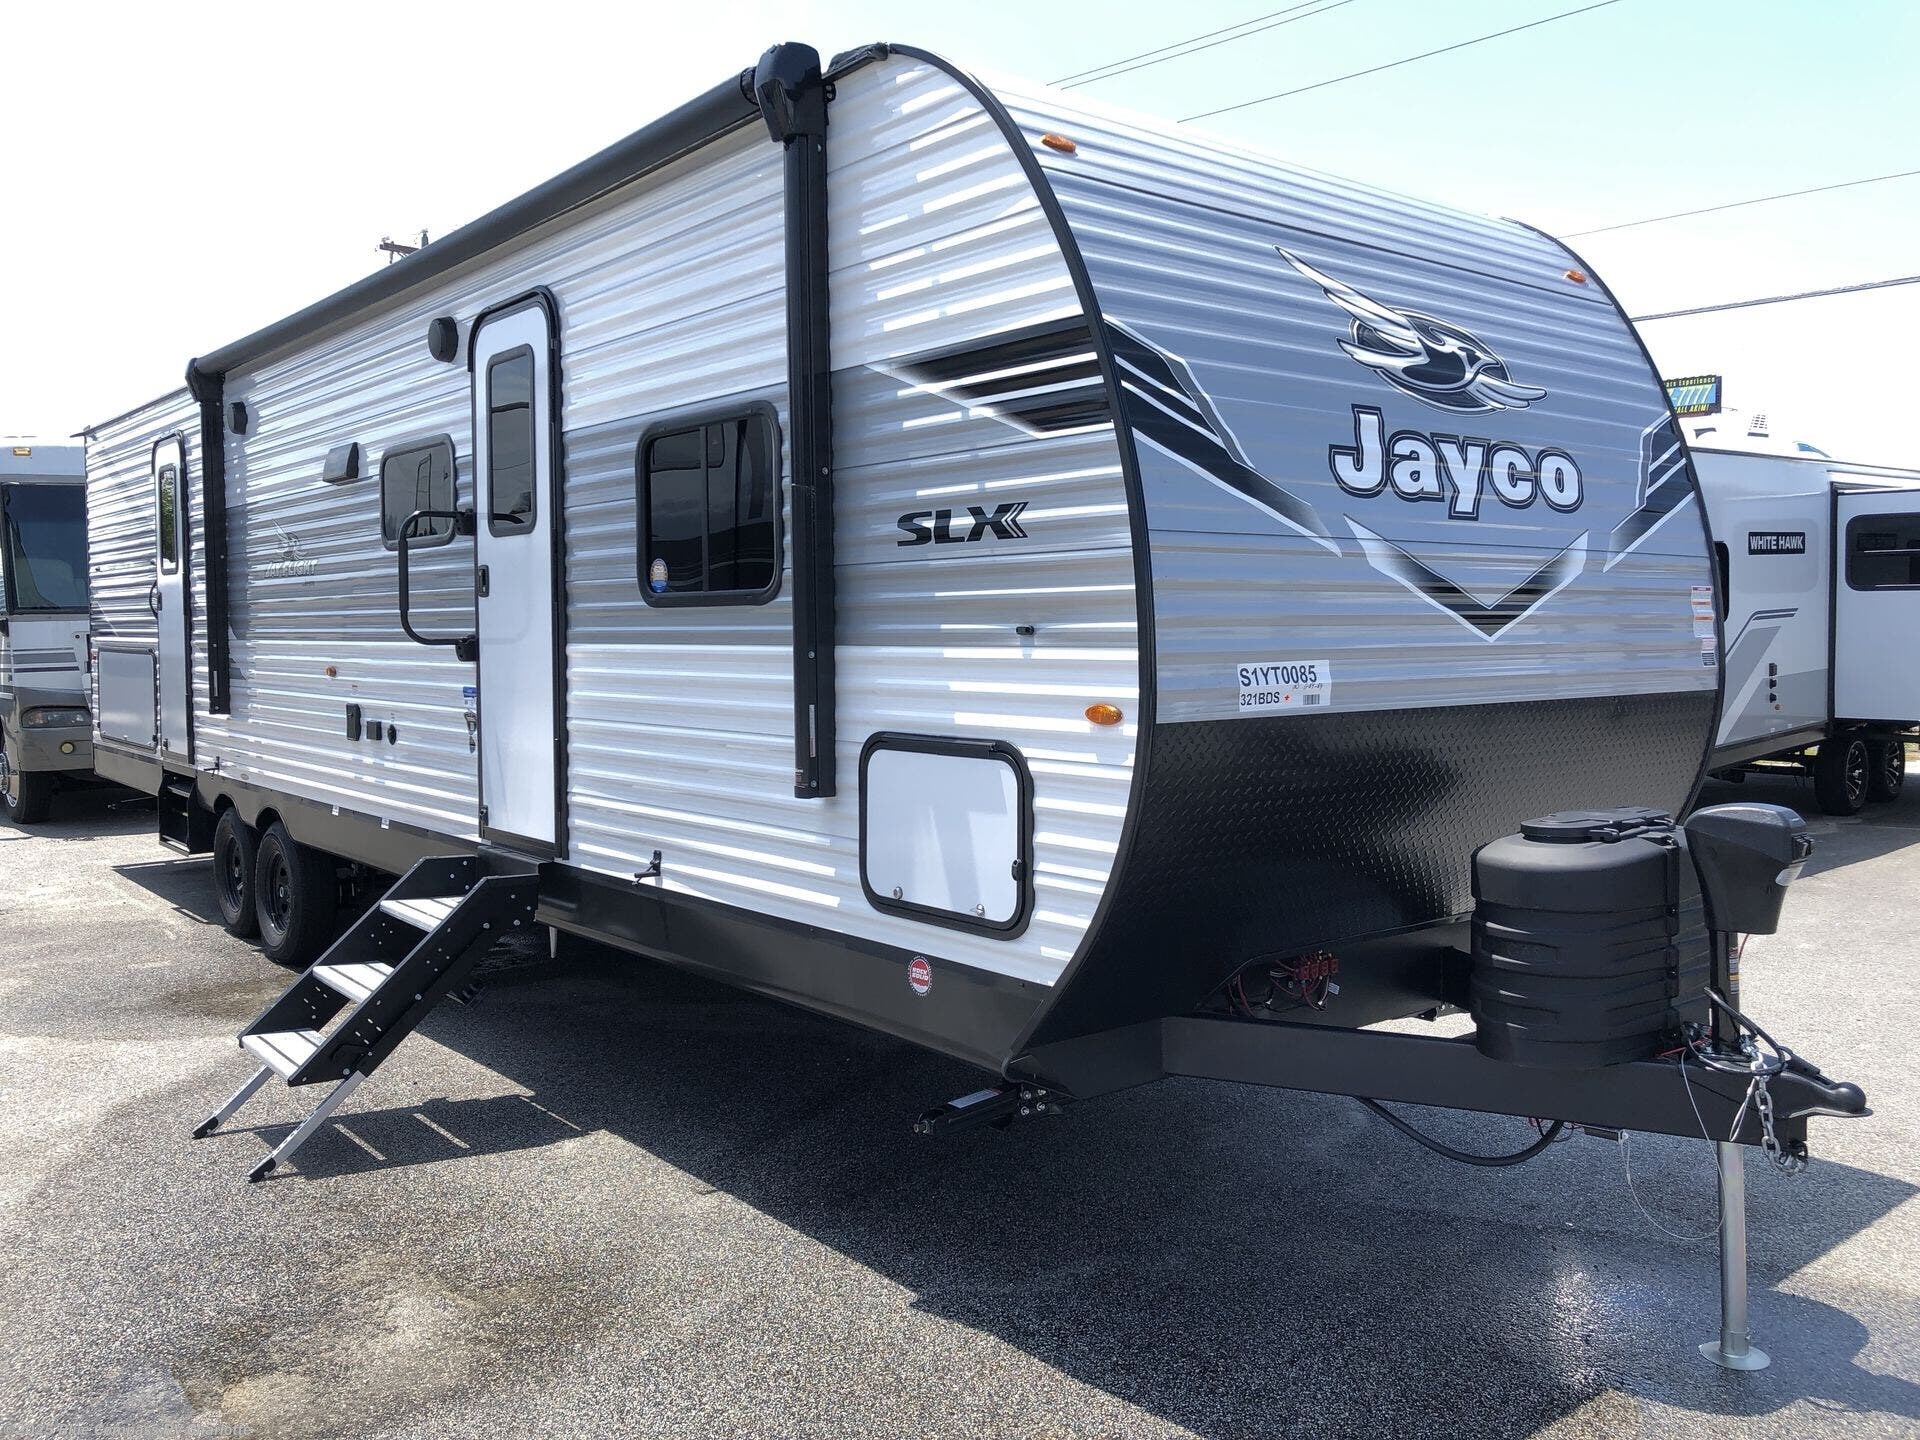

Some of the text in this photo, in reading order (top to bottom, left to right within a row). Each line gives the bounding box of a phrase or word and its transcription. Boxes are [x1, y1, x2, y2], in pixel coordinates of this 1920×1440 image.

[1328, 404, 1584, 521] Jayco
[897, 502, 1029, 547] SLX
[1750, 535, 1803, 550] WHITE HAWK
[1239, 664, 1317, 687] S1YT0085
[1240, 691, 1280, 706] 321BDS
